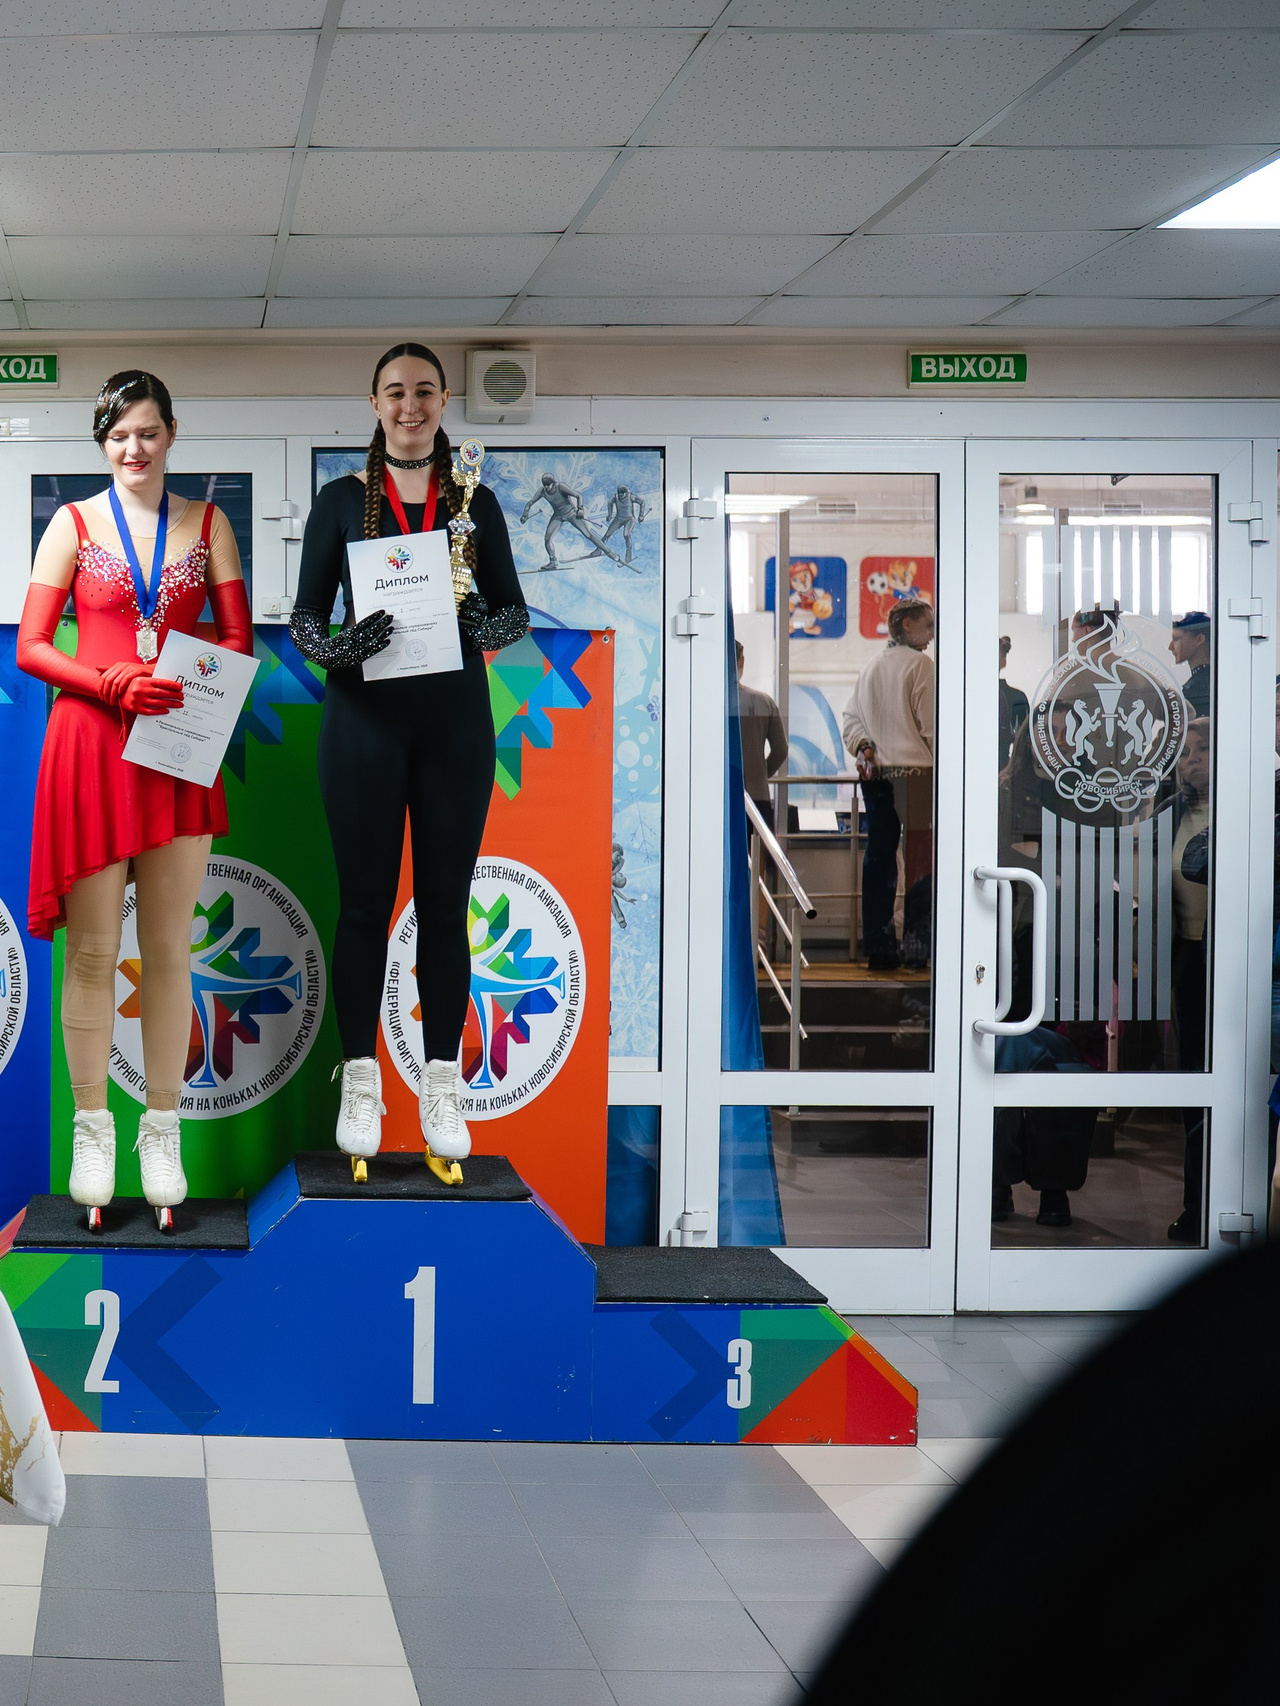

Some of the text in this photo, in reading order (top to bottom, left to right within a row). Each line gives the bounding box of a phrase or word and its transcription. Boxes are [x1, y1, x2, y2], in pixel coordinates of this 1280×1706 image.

[921, 356, 1016, 379] ВЫХОД
[375, 574, 429, 591] Диплом
[175, 675, 225, 699] Диплом
[1037, 714, 1062, 772] УПРАВЛЕНИЕ
[1170, 700, 1180, 738] СПОРТА
[1074, 779, 1143, 795] НОВОСИБИРСК
[206, 863, 309, 939] ТВЕННАЯ ОРГАНИЗАЦИЯ
[472, 865, 572, 939] ЕСТВЕННАЯ ОРГАНИЗАЦИЯ
[109, 1043, 147, 1092] ИГУРНОГО
[196, 1097, 211, 1111] НА
[213, 1084, 261, 1110] КОНЬКАХ
[259, 1008, 317, 1091] НОВОСИБИРСКОЙ
[396, 1038, 421, 1085] ФИГУРН
[476, 1098, 488, 1112] НА
[489, 1082, 531, 1111] КОНЬКАХ
[528, 1008, 578, 1090] НОВОСИБИРСКОЙ
[84, 1289, 120, 1393] 2
[404, 1265, 435, 1405] 1
[727, 1338, 752, 1410] 3
